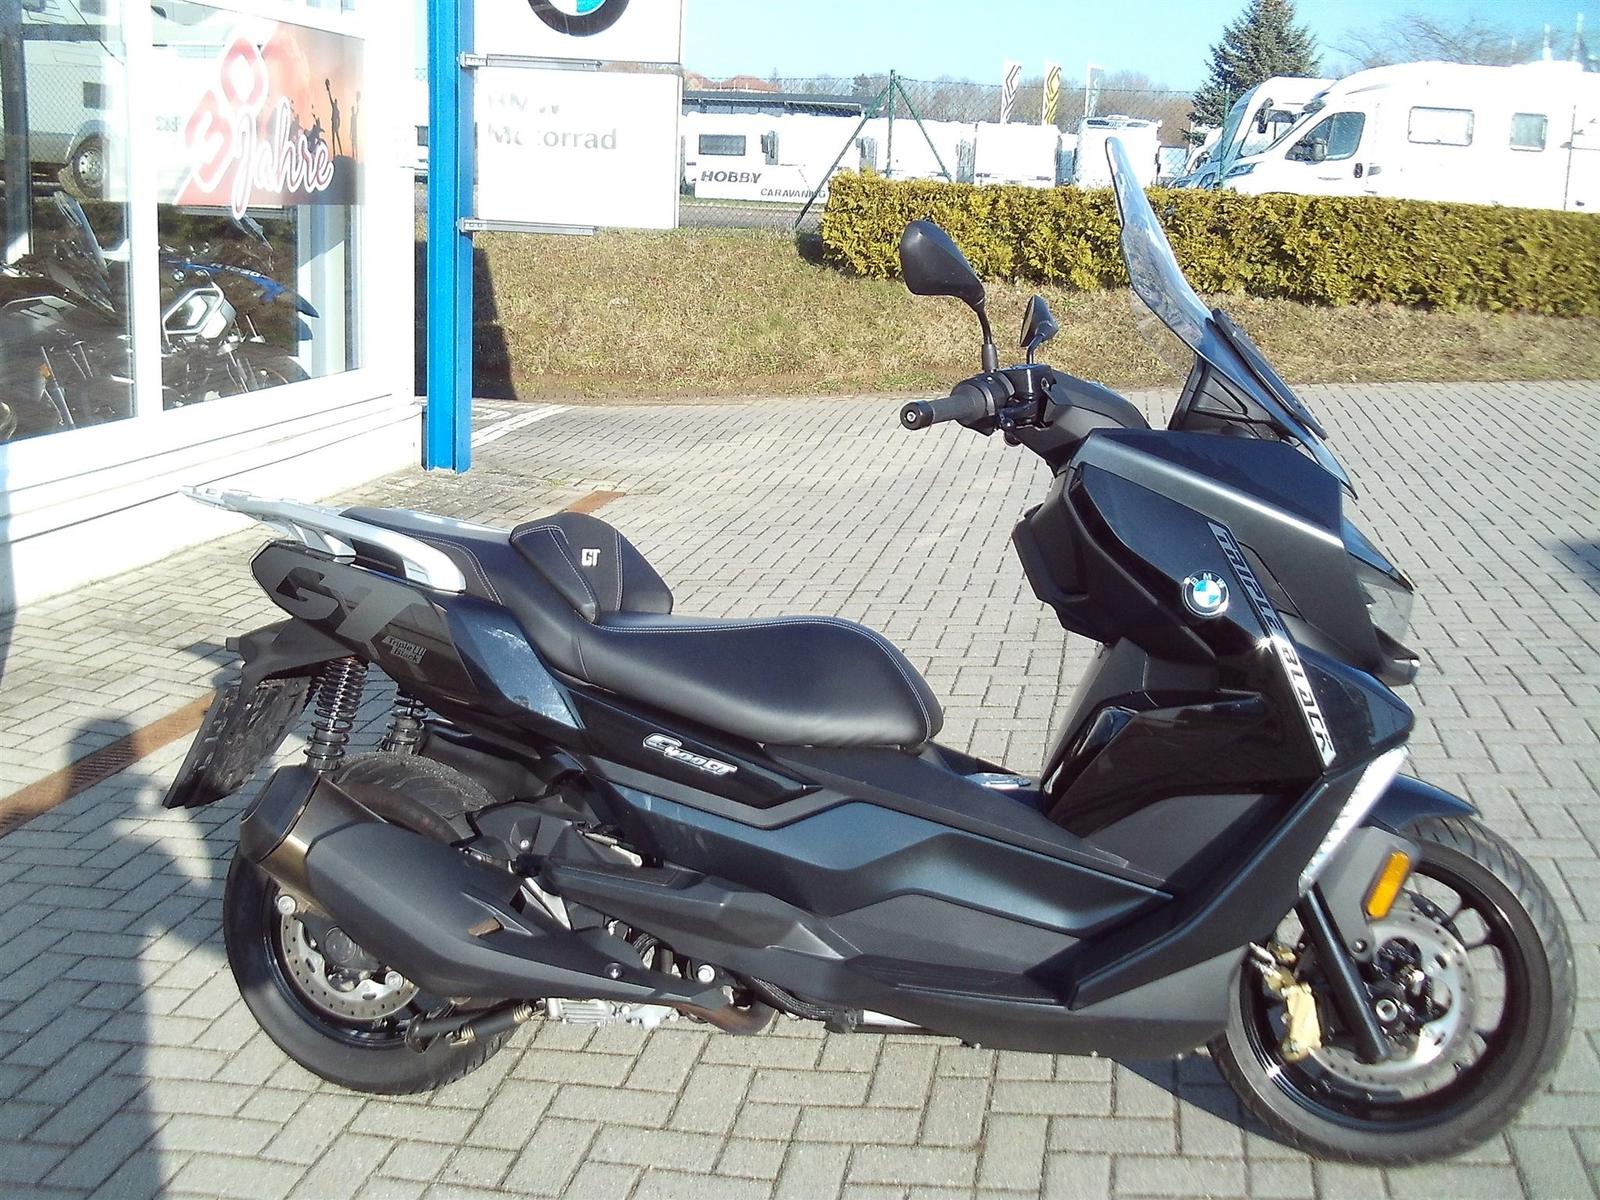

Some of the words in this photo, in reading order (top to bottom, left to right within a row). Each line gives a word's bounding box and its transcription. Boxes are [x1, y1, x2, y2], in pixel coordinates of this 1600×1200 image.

[232, 97, 335, 220] Jahre
[700, 170, 762, 184] HOBBY
[581, 548, 601, 567] GT
[1217, 531, 1284, 632] TRIPLE
[1281, 646, 1334, 754] BLACK
